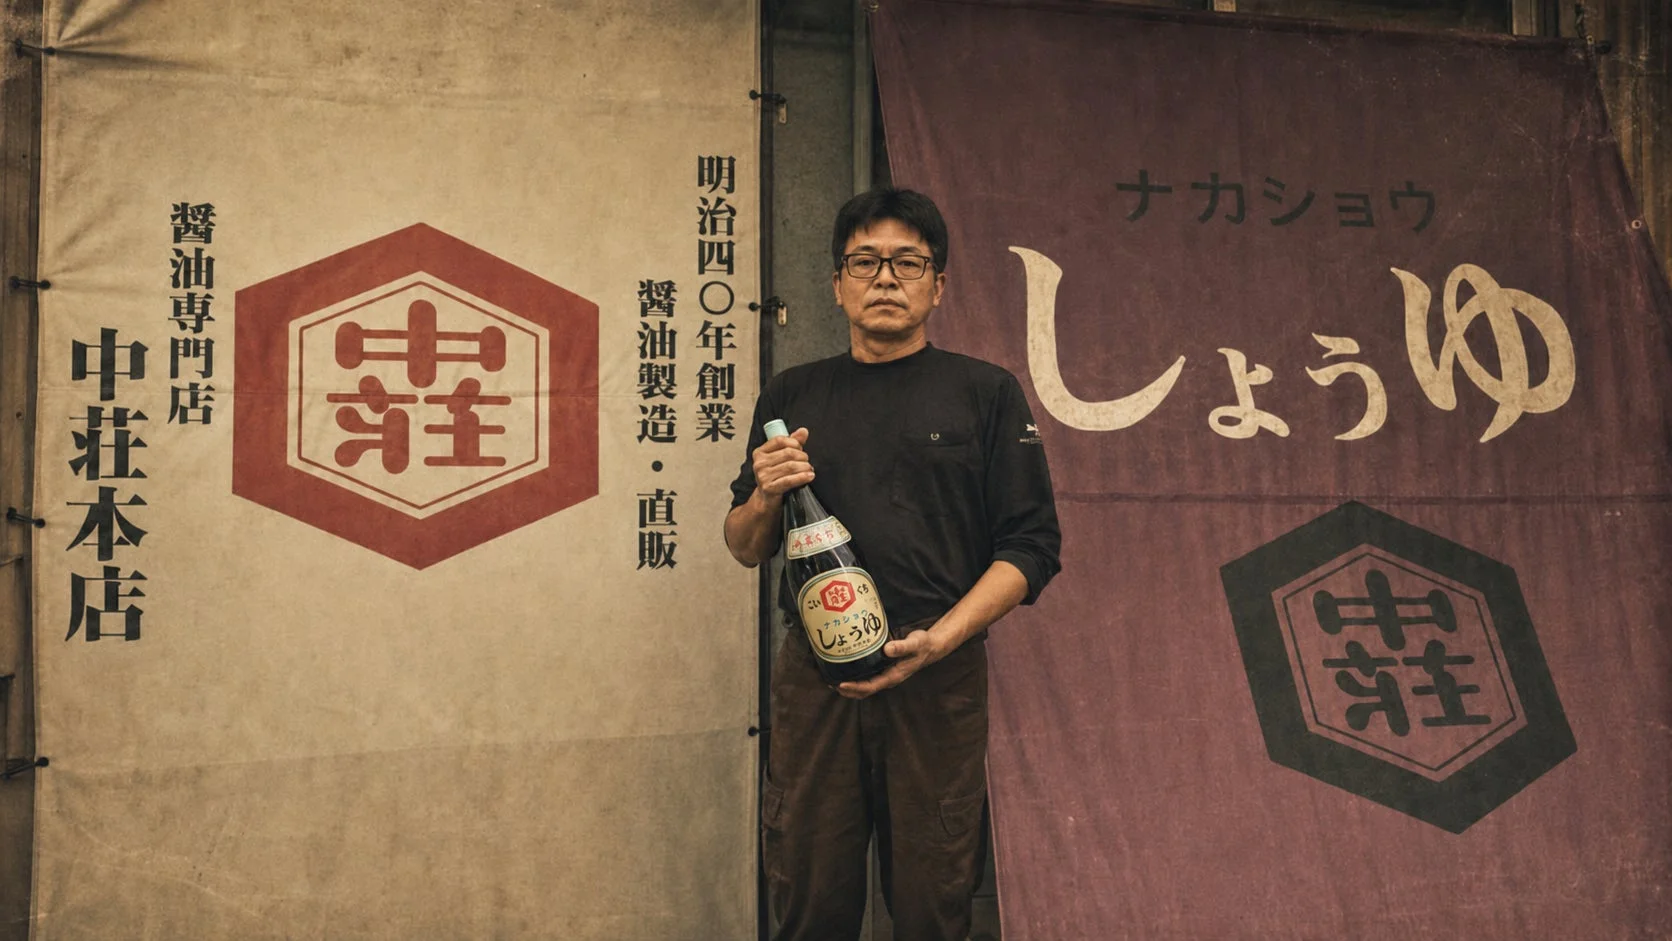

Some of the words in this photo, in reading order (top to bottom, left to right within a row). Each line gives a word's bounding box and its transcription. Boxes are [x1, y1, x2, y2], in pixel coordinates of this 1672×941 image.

[1116, 169, 1435, 233] ナカショウ
[168, 202, 216, 425] 醤油専門店
[1009, 246, 1576, 443] しょうゆ
[65, 327, 148, 642] 中荘本店
[816, 612, 882, 651] しょうゆ
[823, 609, 868, 630] ナカショウ
